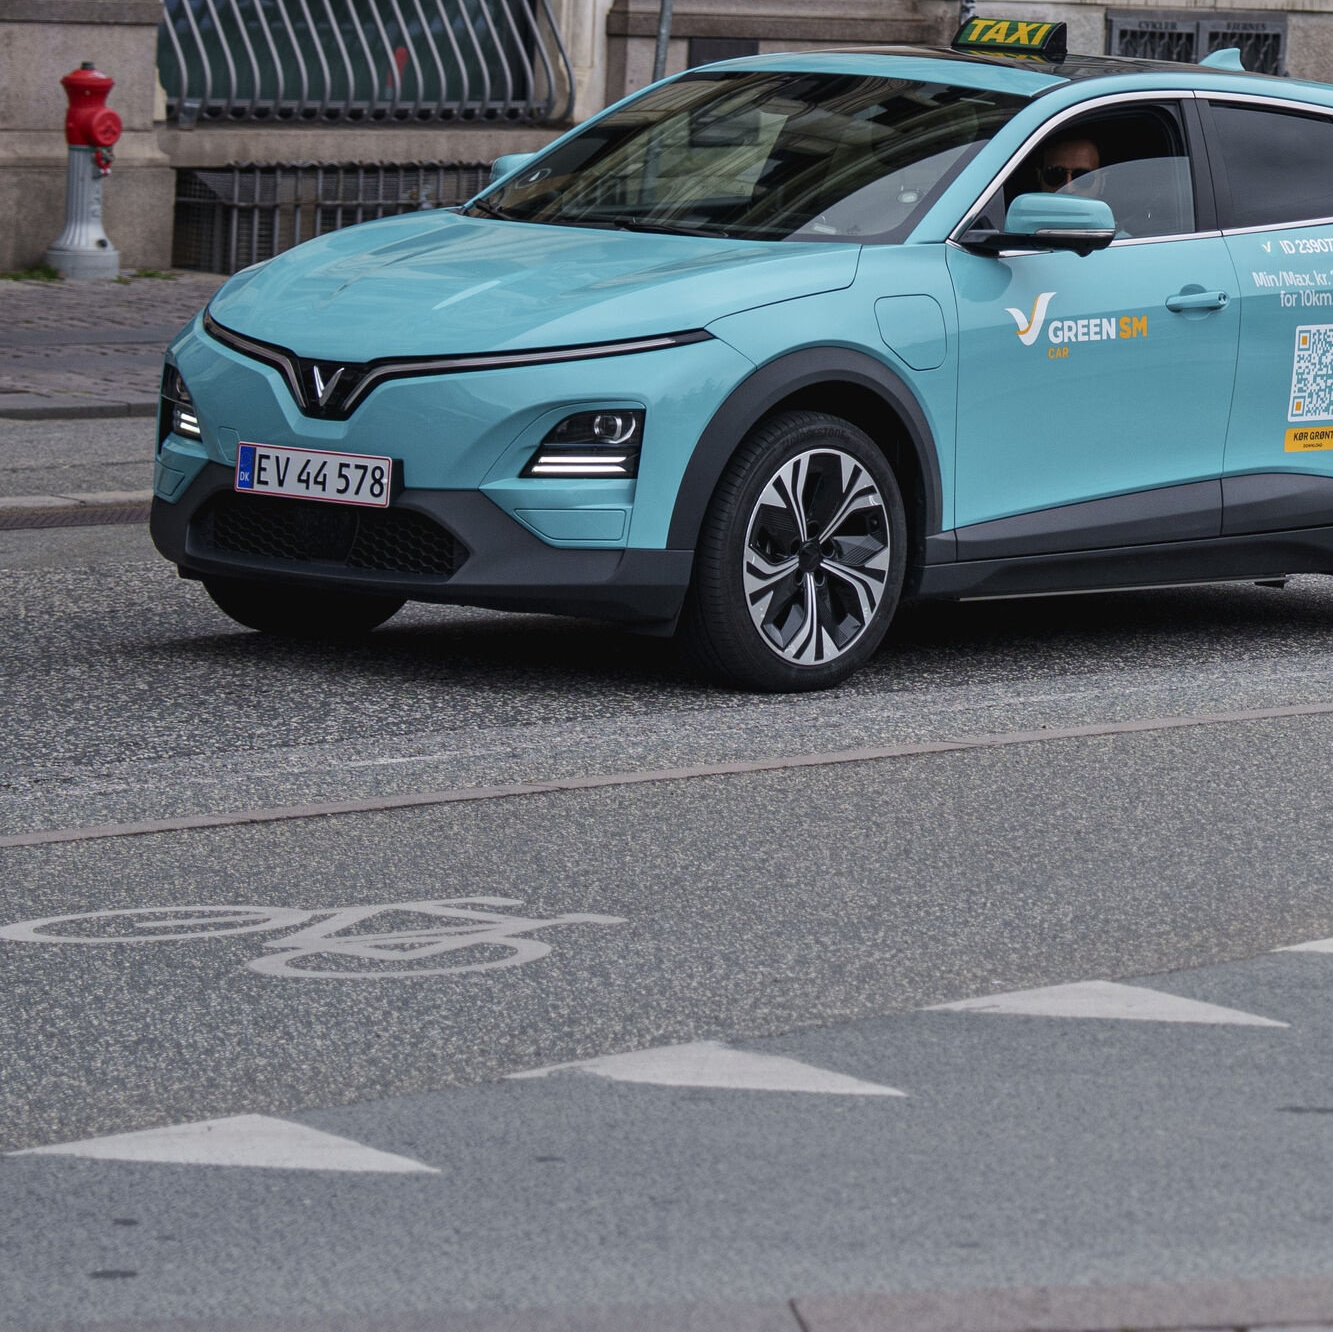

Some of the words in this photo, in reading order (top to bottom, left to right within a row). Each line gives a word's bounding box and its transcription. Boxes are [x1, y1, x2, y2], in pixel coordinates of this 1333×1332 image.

[967, 19, 1053, 45] TAXI
[1279, 240, 1296, 254] ID
[1313, 270, 1331, 286] kr.
[1280, 290, 1298, 307] for
[1047, 317, 1116, 344] GREEN
[1118, 315, 1149, 340] SM
[1047, 346, 1070, 359] CAR
[1293, 431, 1309, 441] KØR
[239, 470, 250, 482] DK
[256, 453, 290, 487] EV
[297, 459, 328, 492] 44
[336, 462, 386, 498] 578
